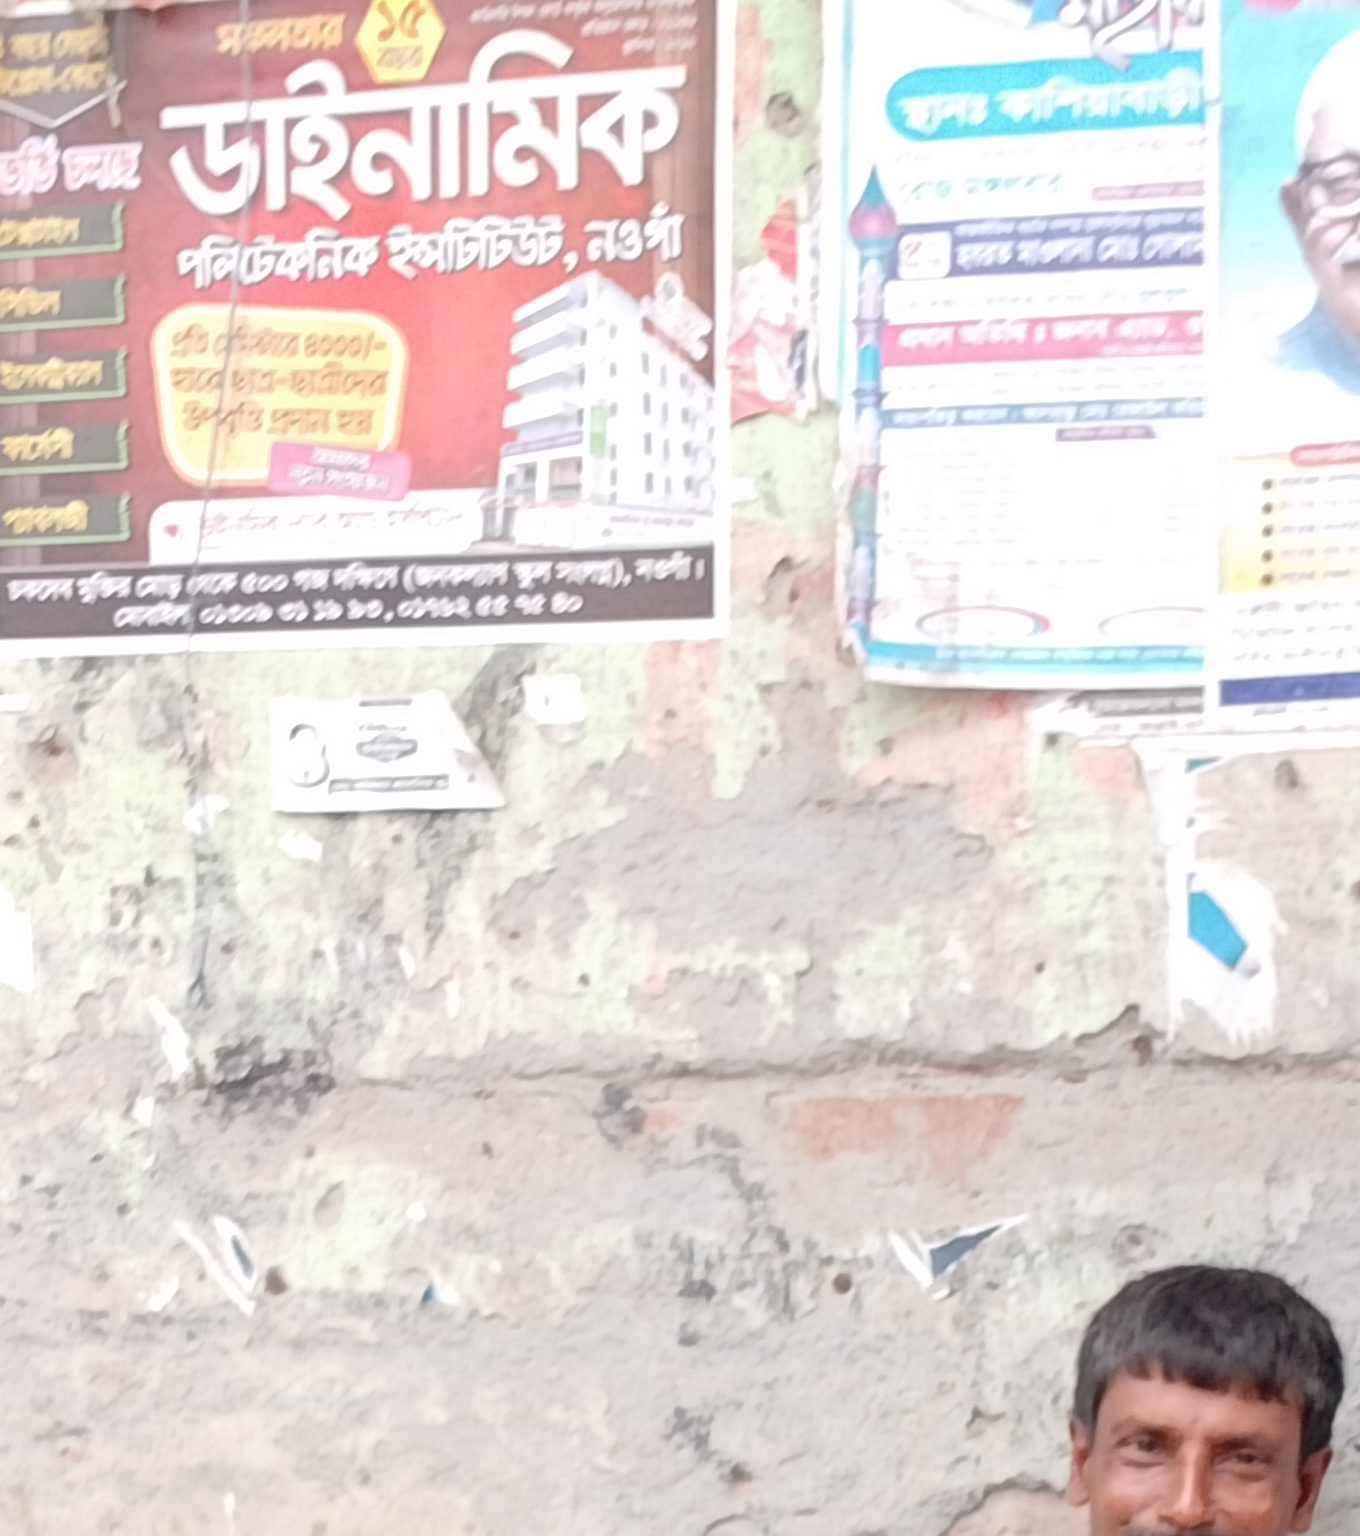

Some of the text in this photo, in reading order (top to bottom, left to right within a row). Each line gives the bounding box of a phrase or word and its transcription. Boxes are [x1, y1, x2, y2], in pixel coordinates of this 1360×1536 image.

[159, 28, 688, 221] ডাইনামিক
[177, 226, 380, 289] পলিটেকনিক
[584, 200, 686, 262] নওগাঁ
